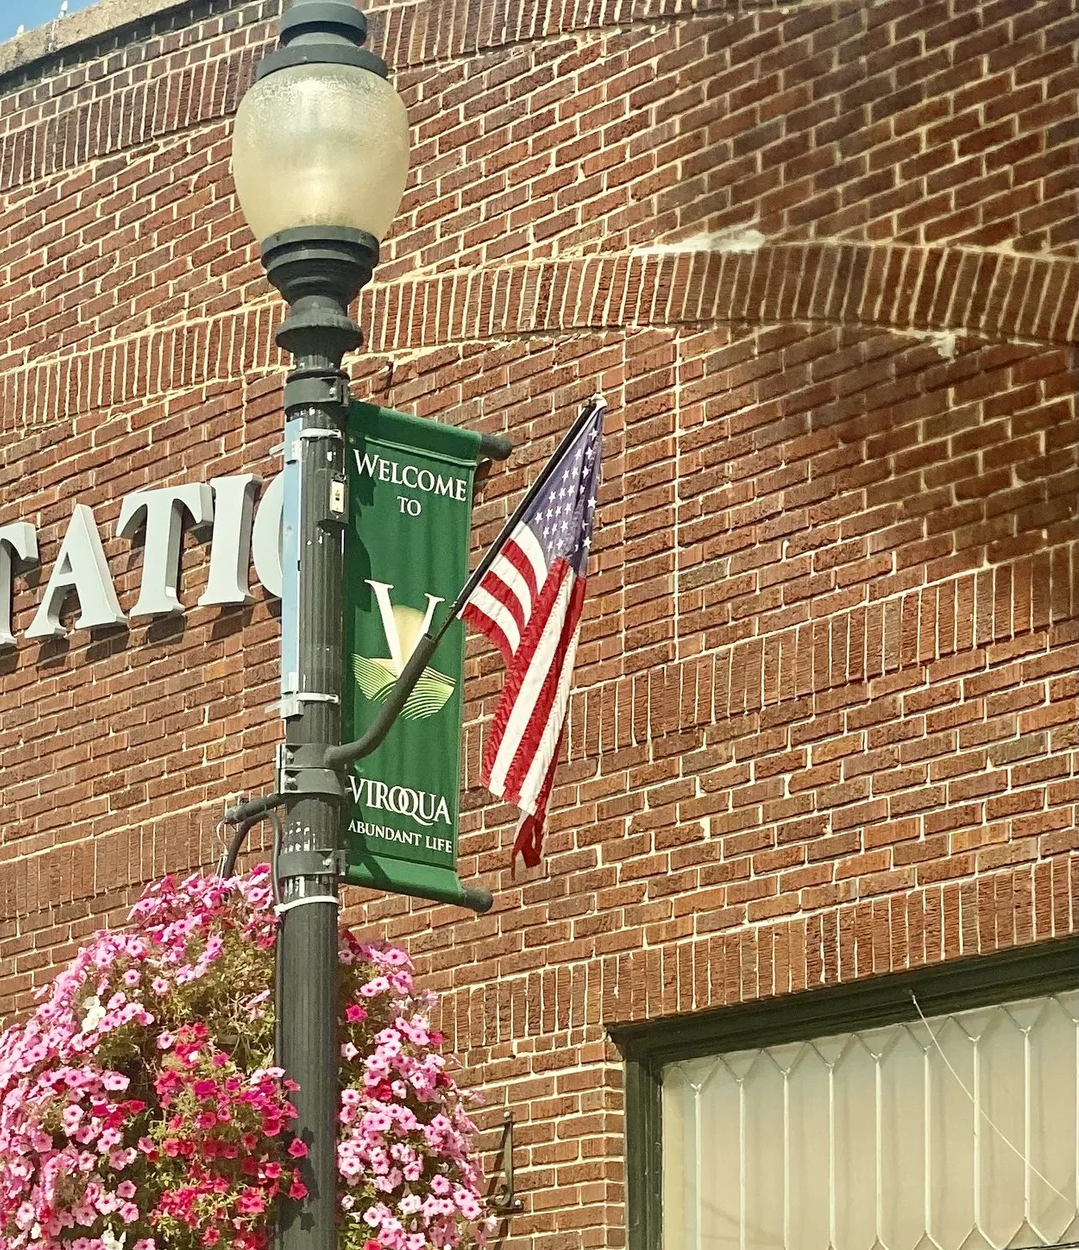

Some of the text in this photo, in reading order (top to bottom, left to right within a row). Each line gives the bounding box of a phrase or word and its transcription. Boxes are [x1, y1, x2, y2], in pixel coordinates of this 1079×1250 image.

[353, 448, 467, 502] WELCOME
[397, 495, 422, 517] TO
[347, 774, 452, 827] VIROQUA
[347, 818, 454, 854] ABUNDANT LIFE
